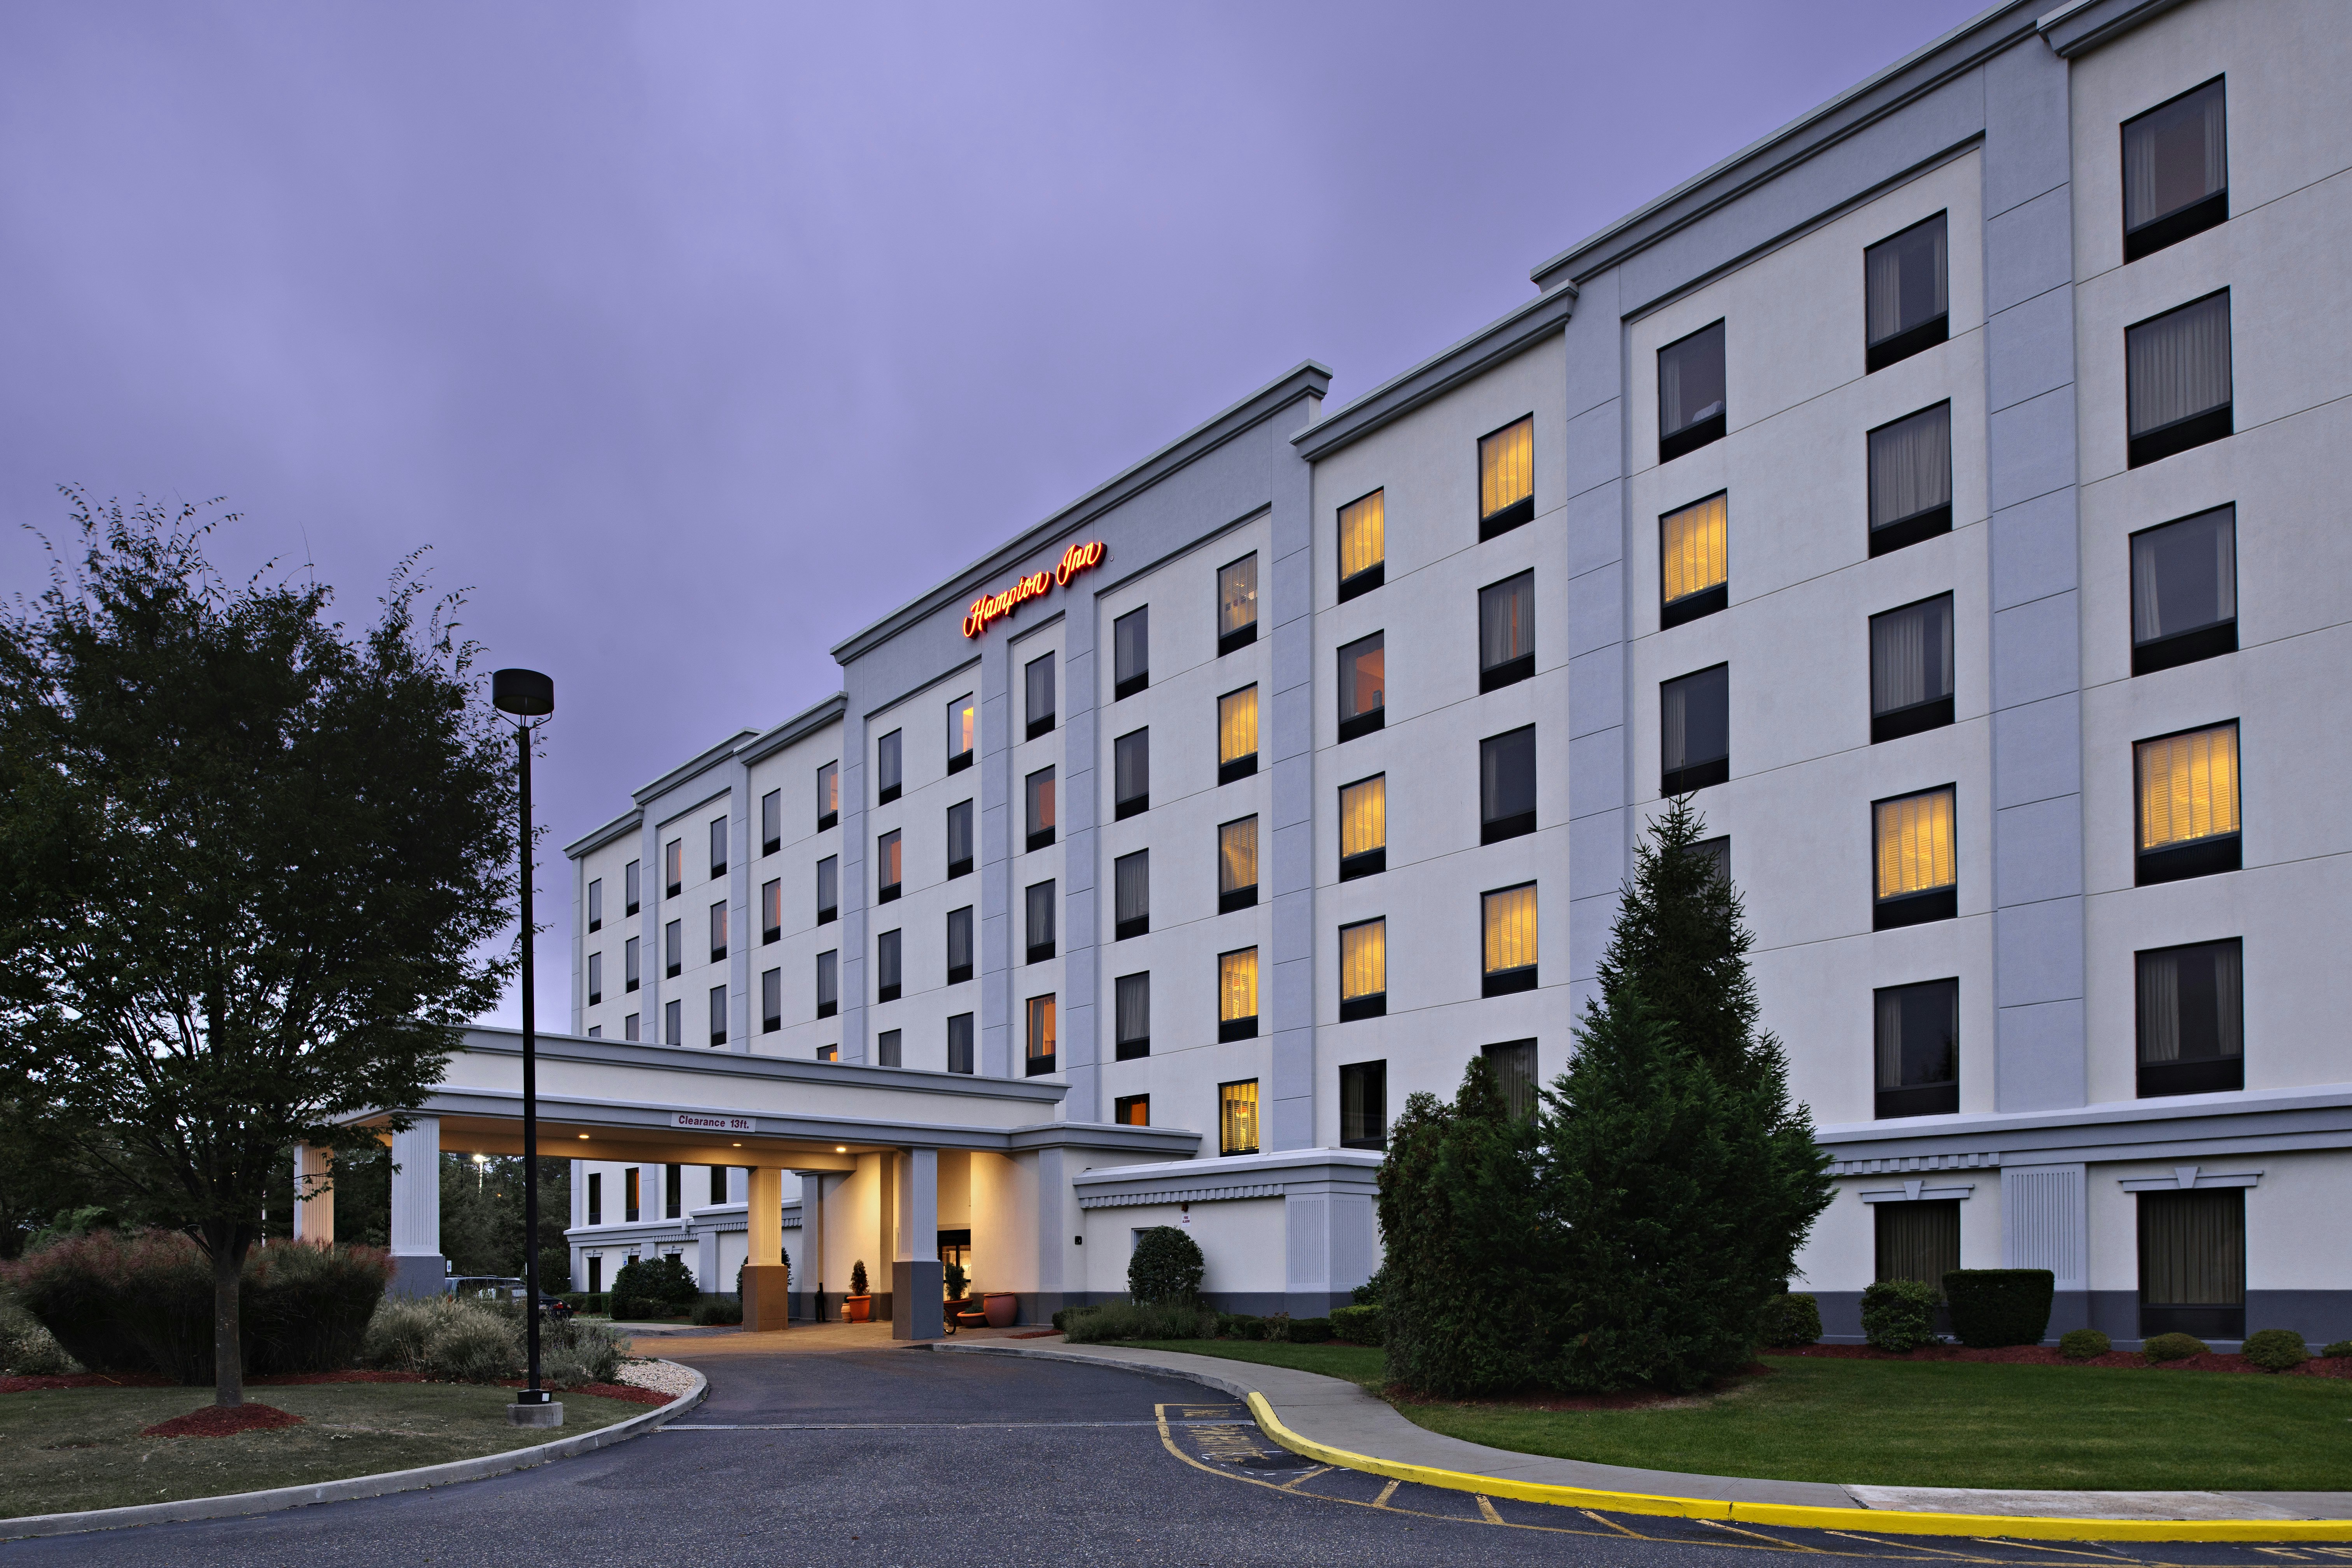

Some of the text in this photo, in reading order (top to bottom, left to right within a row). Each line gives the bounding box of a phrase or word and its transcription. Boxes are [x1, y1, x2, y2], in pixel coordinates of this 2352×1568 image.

[963, 541, 1103, 638] Hampton Inn
[679, 1115, 749, 1129] Clearance 13ft.
